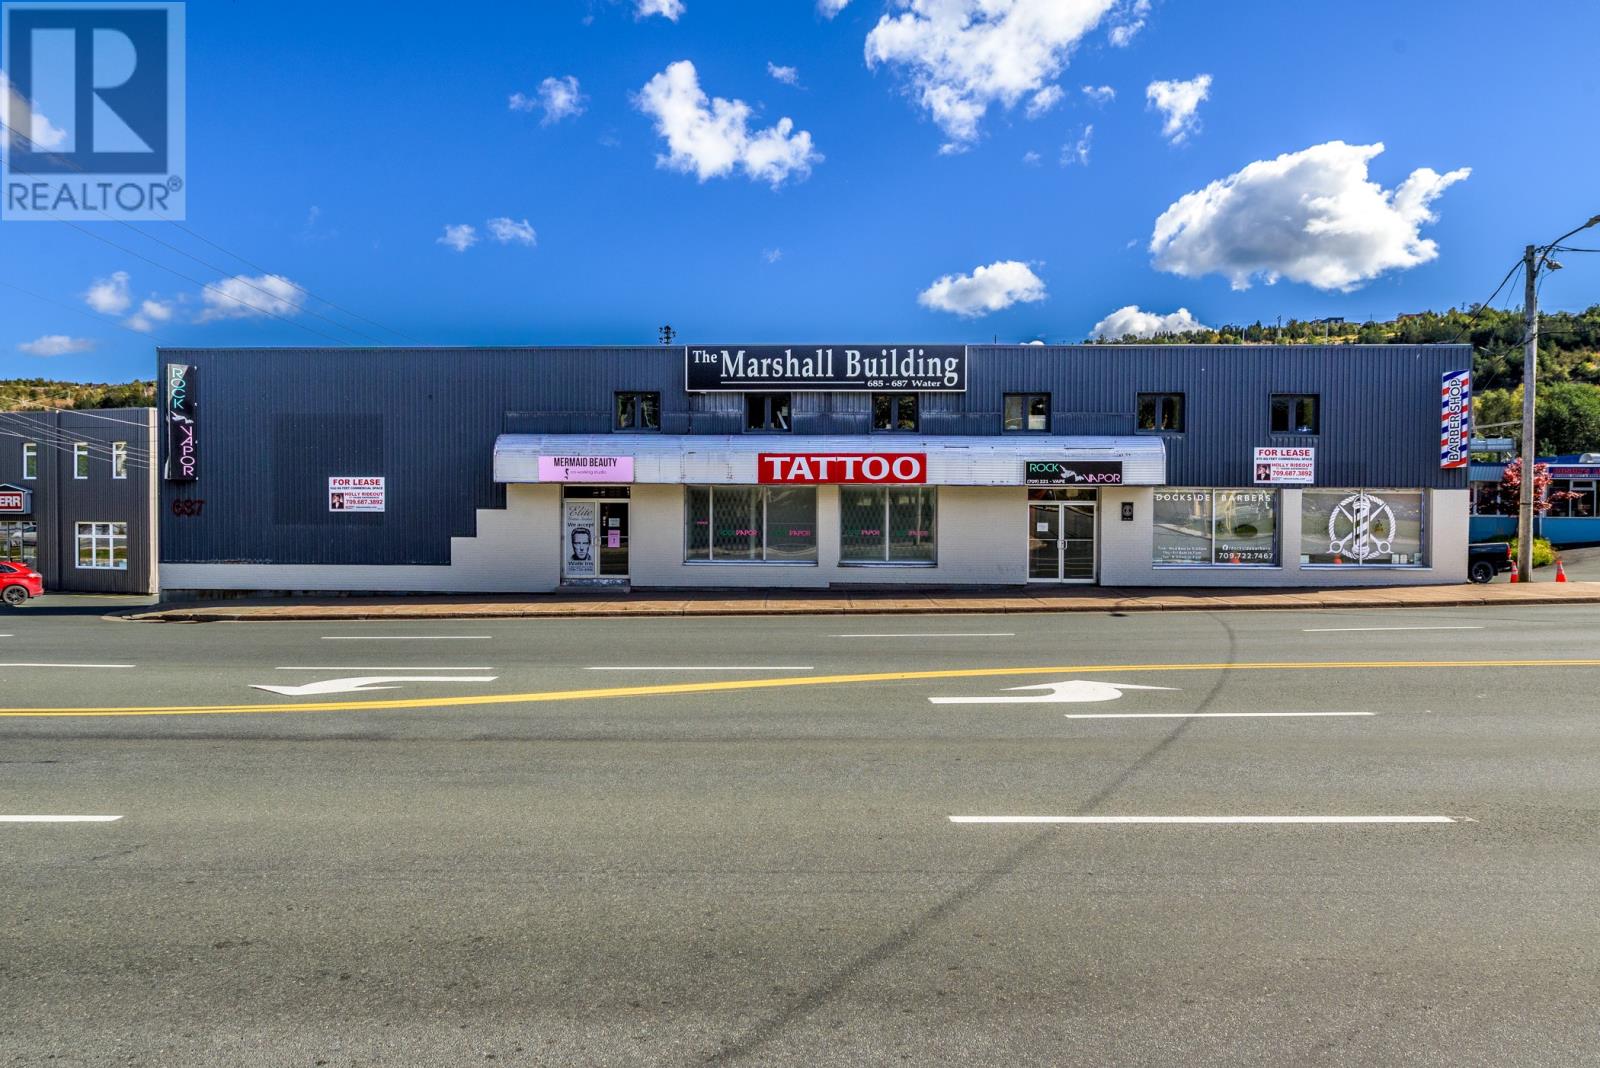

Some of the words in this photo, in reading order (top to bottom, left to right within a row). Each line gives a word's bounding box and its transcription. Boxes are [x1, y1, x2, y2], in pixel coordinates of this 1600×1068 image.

[692, 350, 718, 363] The
[720, 349, 834, 378] Marshall
[845, 349, 959, 387] Building
[171, 367, 186, 409] ROCK
[867, 380, 884, 388] 685
[891, 380, 908, 388] 687
[911, 380, 941, 388] Water
[180, 425, 195, 476] VAPOR
[553, 457, 588, 467] MERMAID
[589, 457, 617, 467] BEAUTY
[764, 456, 921, 480] TATTOO
[1029, 463, 1060, 472] ROCK
[1083, 473, 1121, 483] VAPOR
